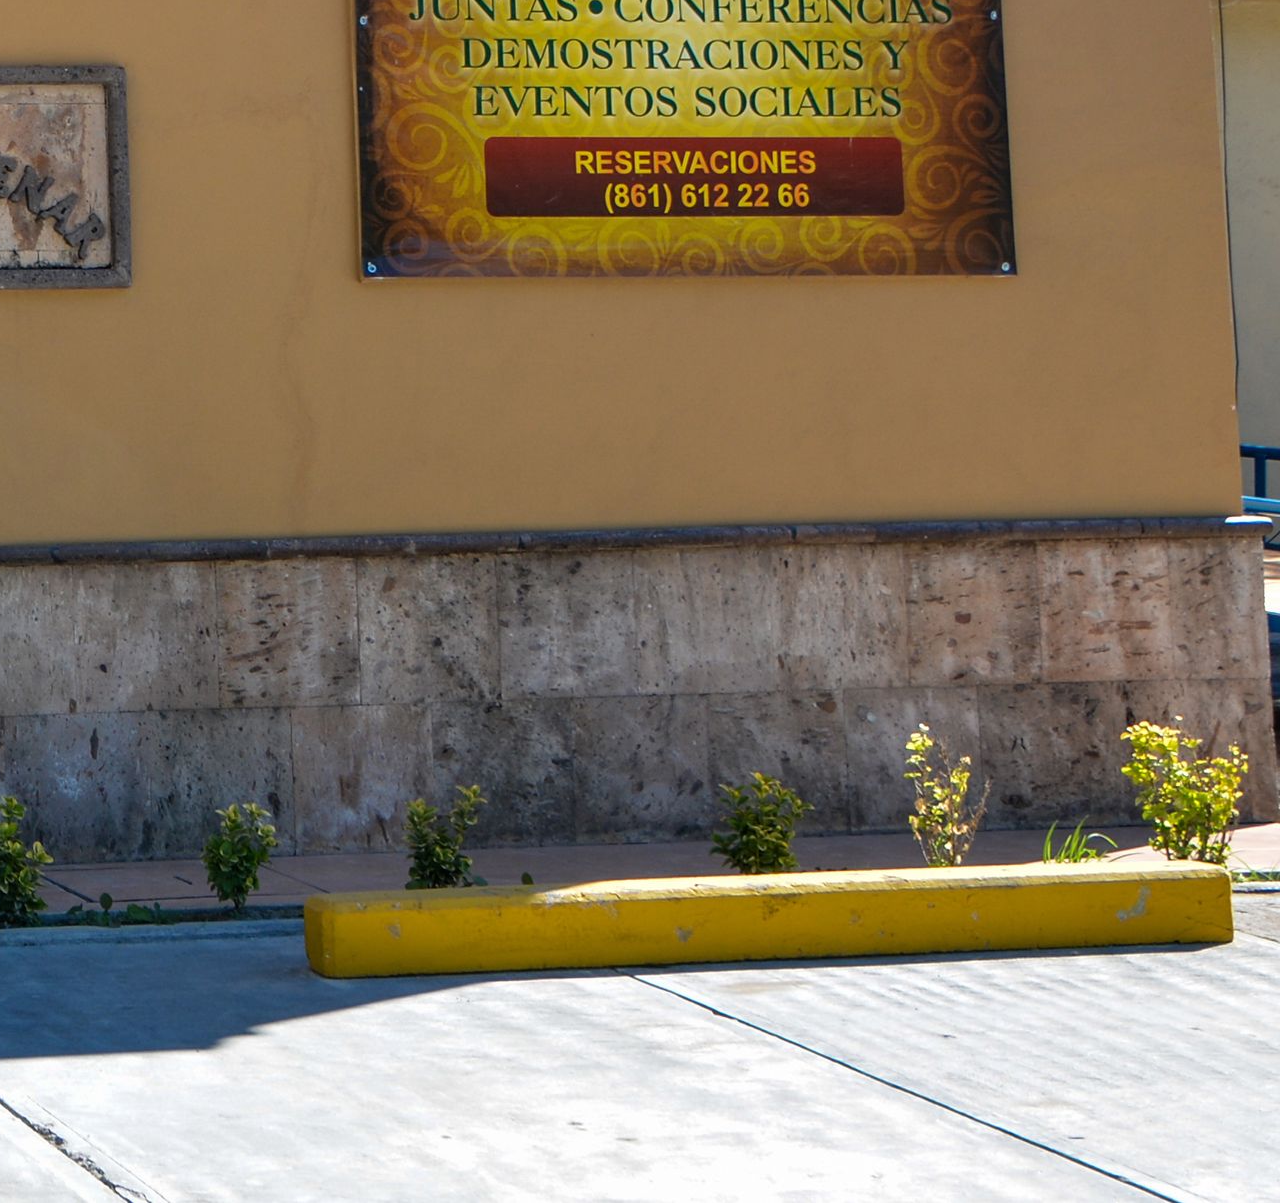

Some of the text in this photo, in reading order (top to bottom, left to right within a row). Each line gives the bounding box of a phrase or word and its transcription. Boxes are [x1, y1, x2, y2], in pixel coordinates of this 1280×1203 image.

[461, 37, 909, 71] DEMOSTRACIONES Y
[473, 85, 902, 118] EVENTOS SOCIALES
[575, 149, 816, 175] RESERVACIONES
[604, 182, 810, 214] (861) 612 22 66
